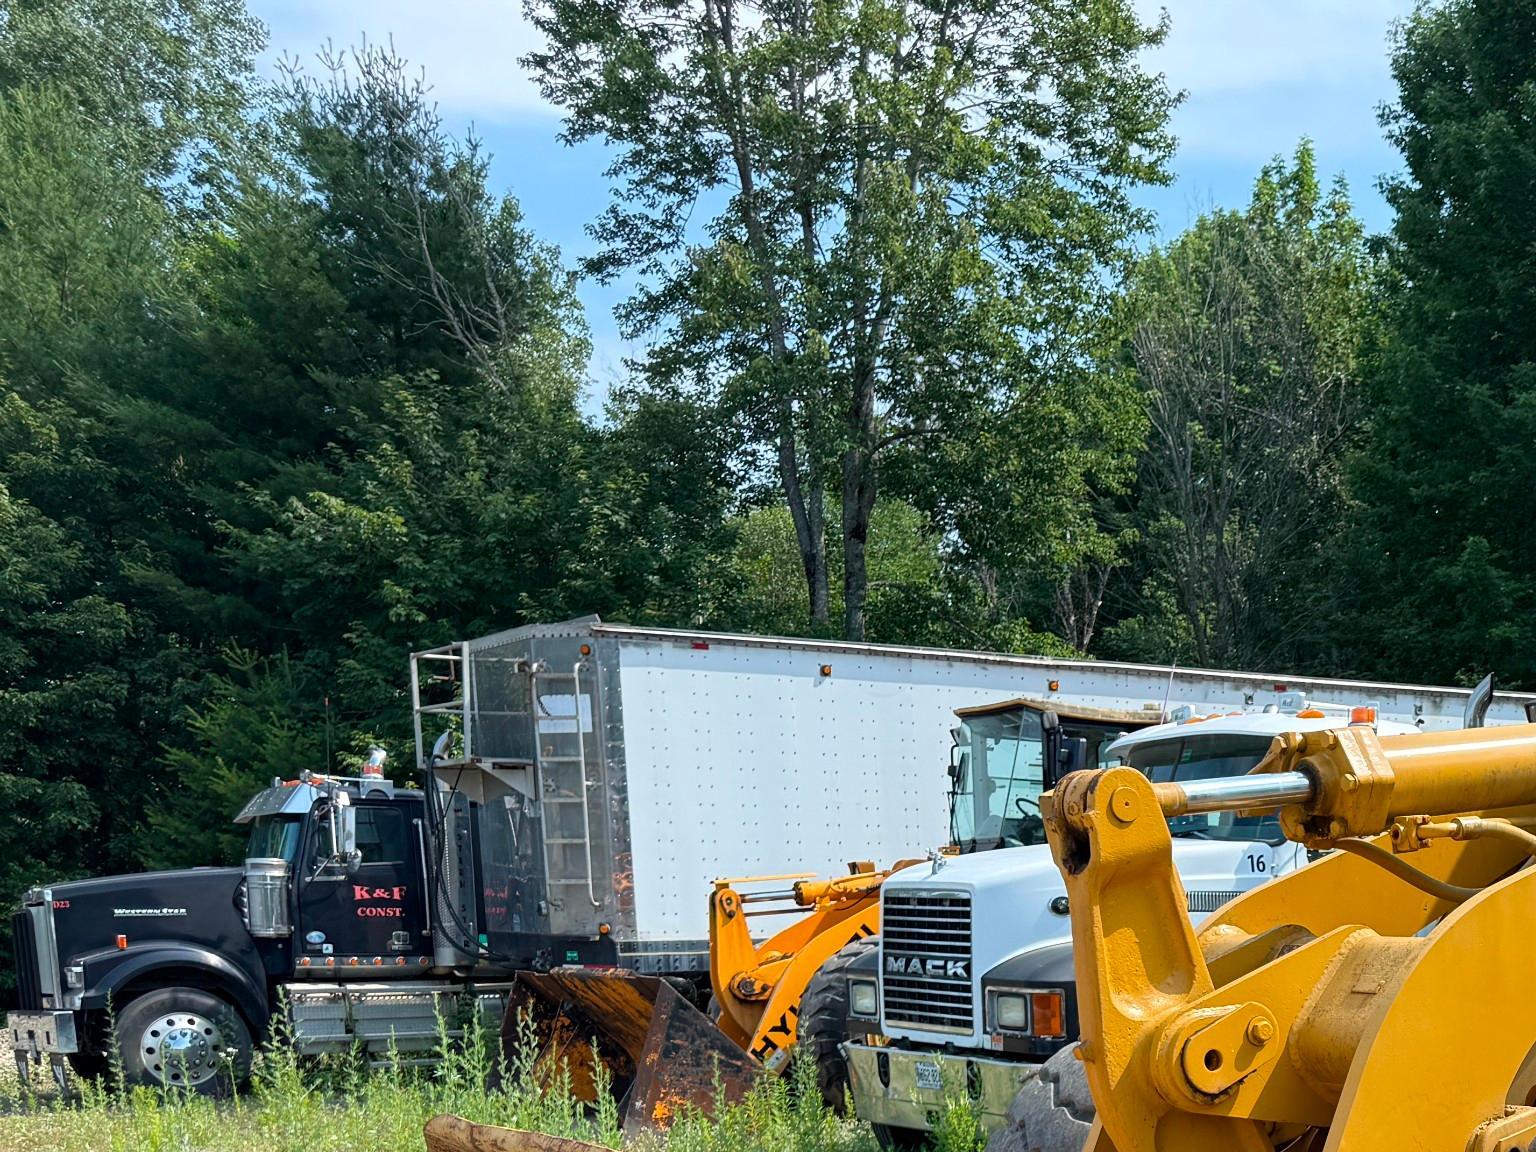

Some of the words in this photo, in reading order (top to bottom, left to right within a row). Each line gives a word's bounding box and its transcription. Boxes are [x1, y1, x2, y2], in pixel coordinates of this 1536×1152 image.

[1247, 854, 1266, 873] 16
[356, 907, 406, 917] CONST.
[887, 956, 969, 978] MACK
